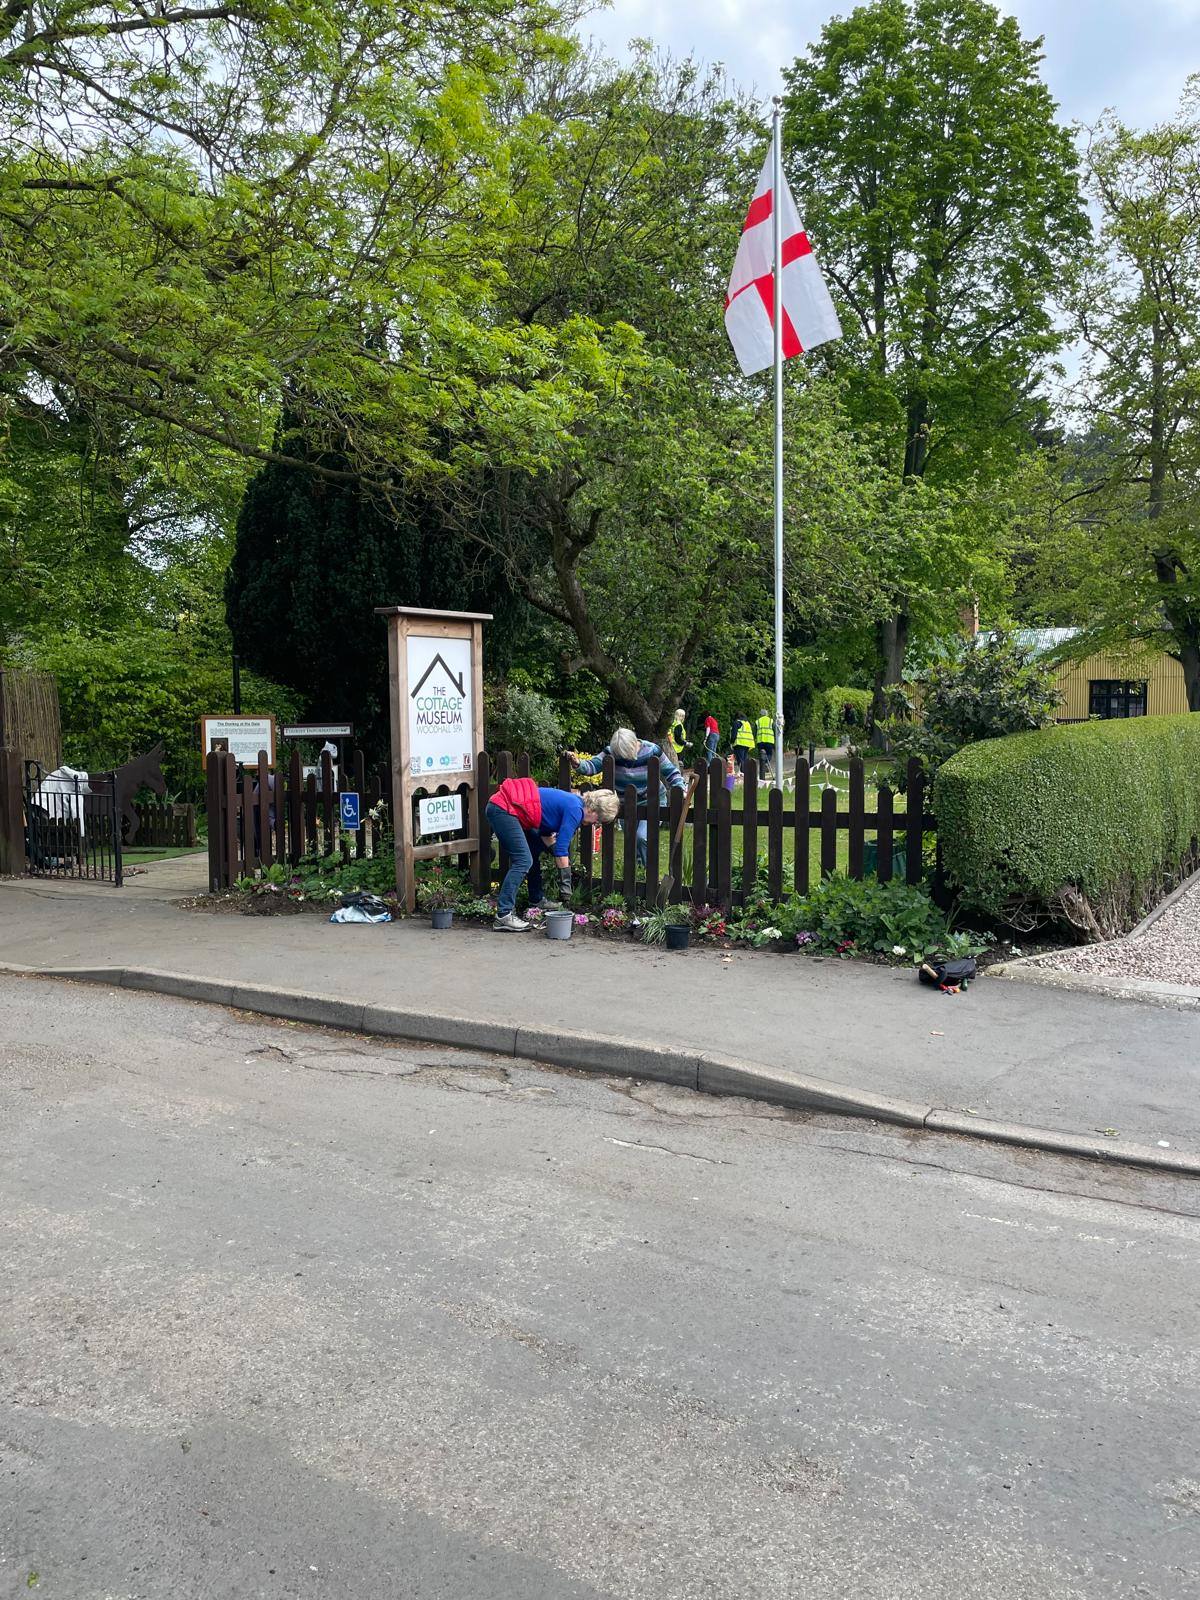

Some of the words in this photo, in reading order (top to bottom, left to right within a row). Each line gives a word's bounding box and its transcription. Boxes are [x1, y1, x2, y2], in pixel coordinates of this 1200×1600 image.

[433, 686, 446, 696] THE
[416, 697, 463, 711] COTTAGE
[416, 711, 463, 725] MUSEUM
[416, 724, 452, 735] WOODHALL
[453, 724, 463, 734] SPA
[427, 799, 455, 814] OPEN
